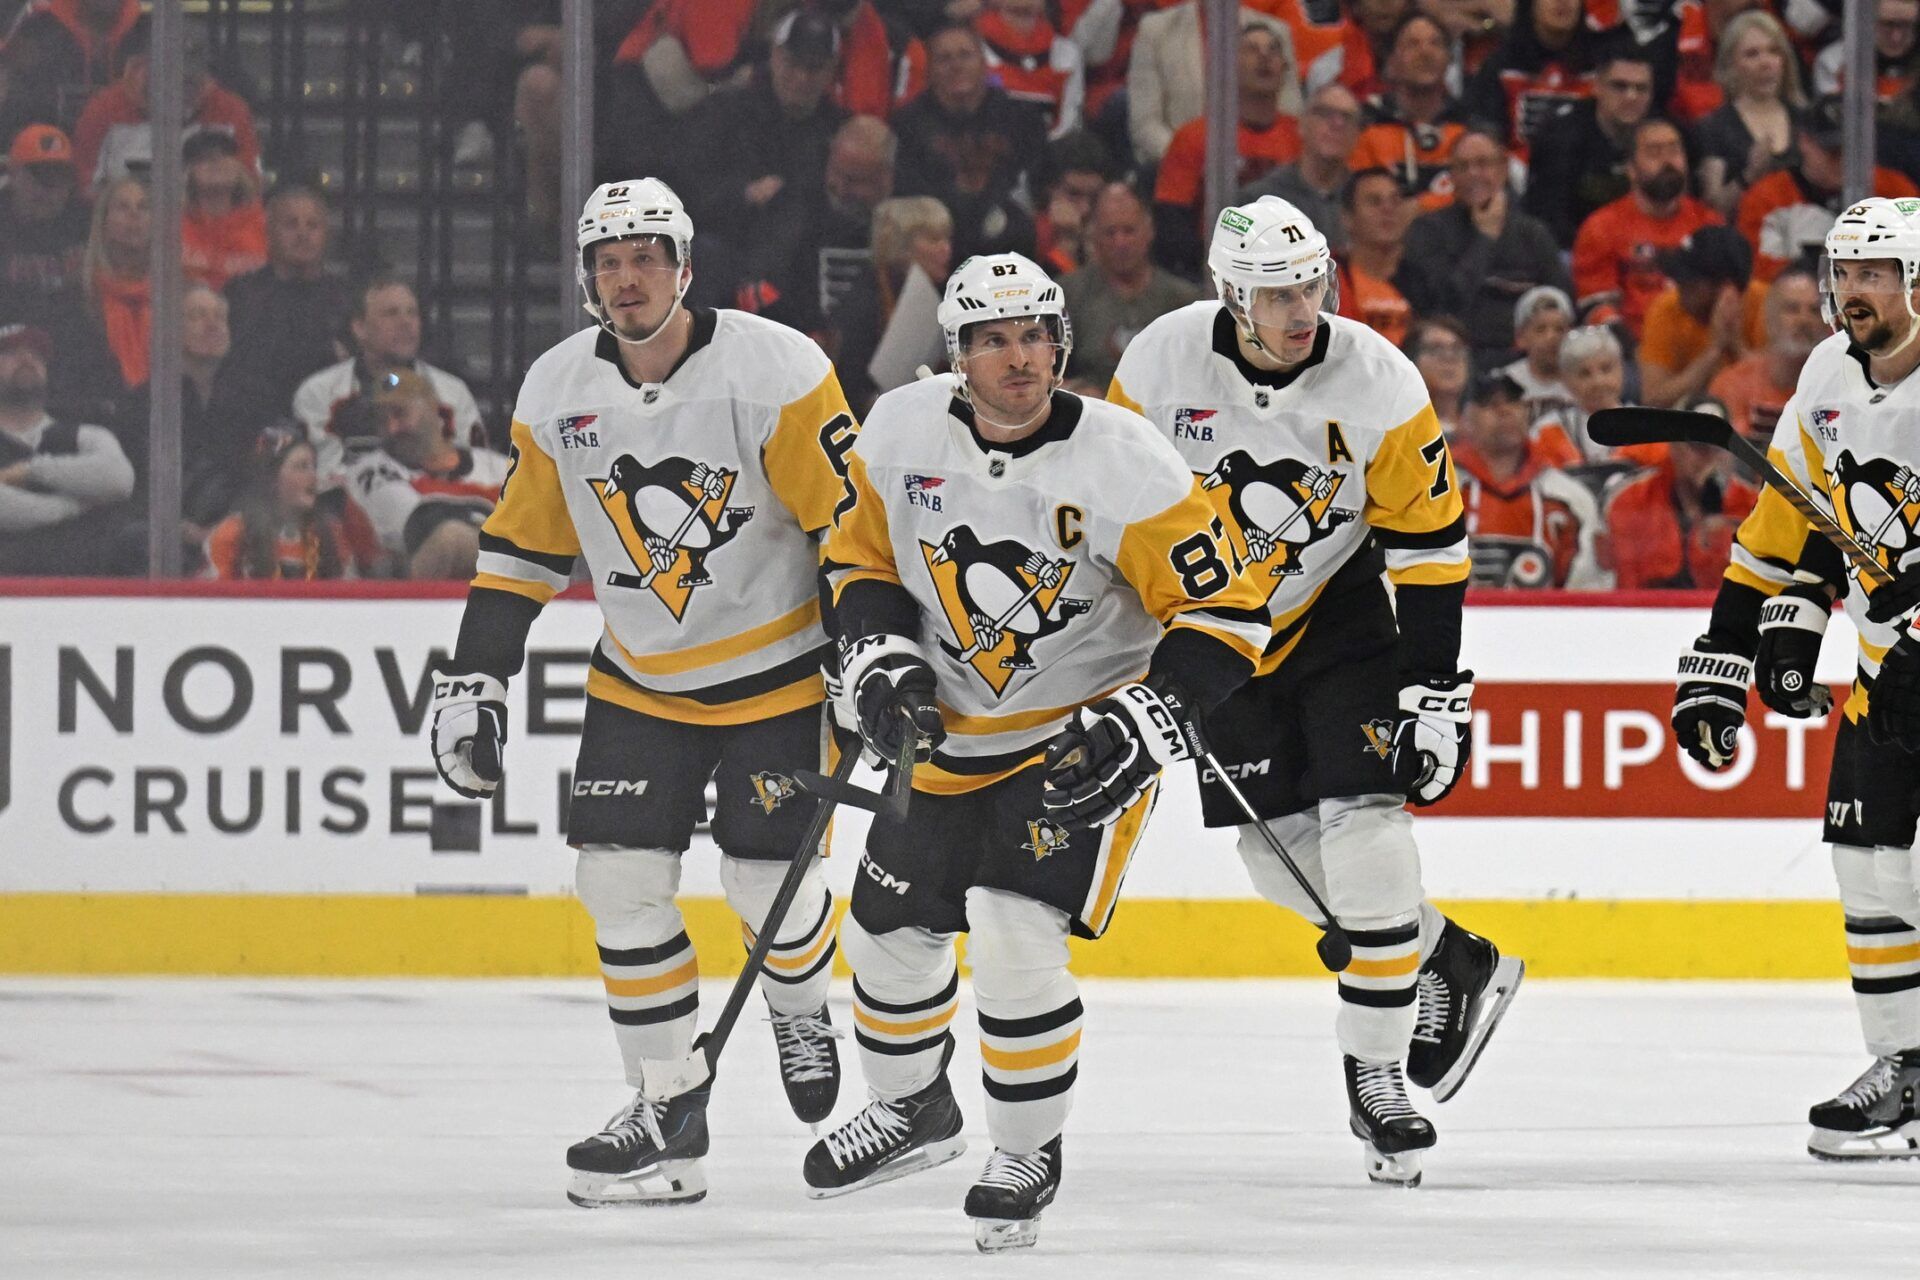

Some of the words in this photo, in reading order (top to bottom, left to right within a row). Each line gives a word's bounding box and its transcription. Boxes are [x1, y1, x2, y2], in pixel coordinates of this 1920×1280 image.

[1221, 209, 1254, 233] MSA
[1281, 224, 1306, 243] 71
[992, 264, 1018, 277] 87
[994, 289, 1030, 300] CCM
[1326, 420, 1354, 464] A
[1419, 432, 1450, 500] 7
[1055, 503, 1084, 552] C
[1125, 685, 1184, 757] CCM
[1163, 694, 1182, 710] 87
[1183, 720, 1205, 758] PENGUINS
[57, 765, 437, 836] CRUISE
[573, 779, 649, 797] CCM
[860, 847, 912, 896] CCM
